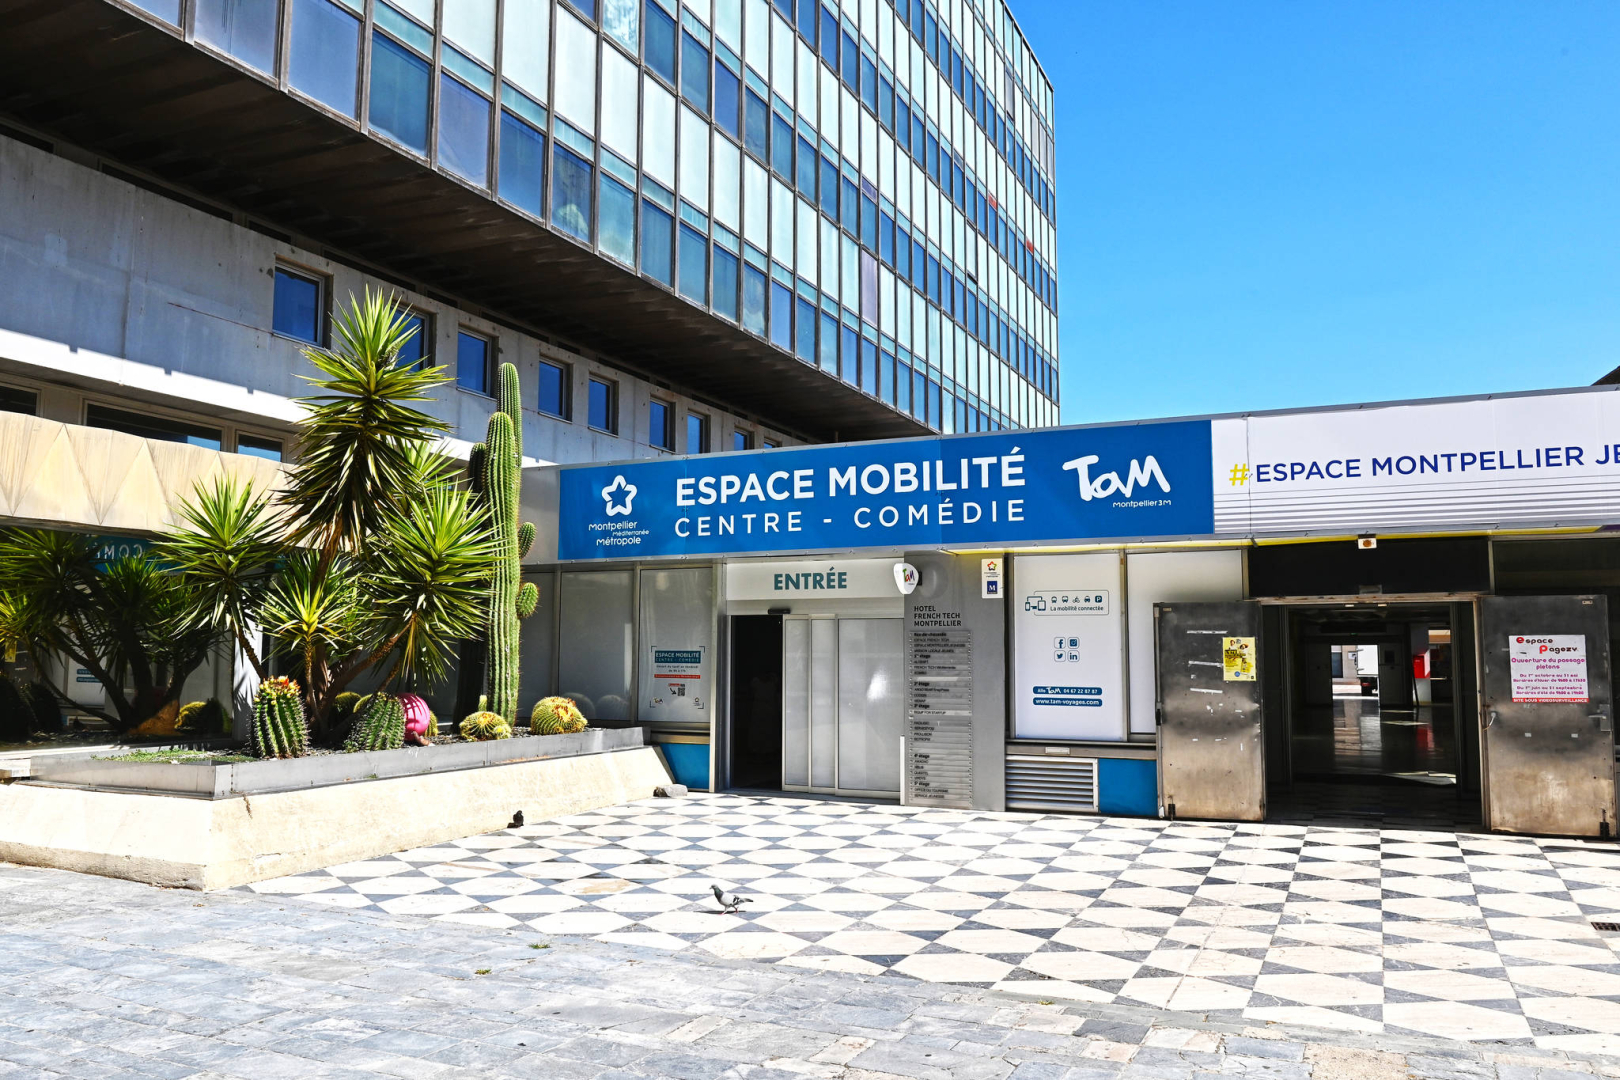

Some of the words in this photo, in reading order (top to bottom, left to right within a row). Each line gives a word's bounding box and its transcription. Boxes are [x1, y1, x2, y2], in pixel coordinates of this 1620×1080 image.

[676, 468, 815, 507] ESPACE
[828, 446, 1026, 498] MOBILITÉ
[1372, 446, 1585, 477] MONTPELLIER
[674, 511, 802, 538] CENTRE
[853, 498, 1025, 529] COMÉDIE
[773, 566, 848, 590] ENTRÉE
